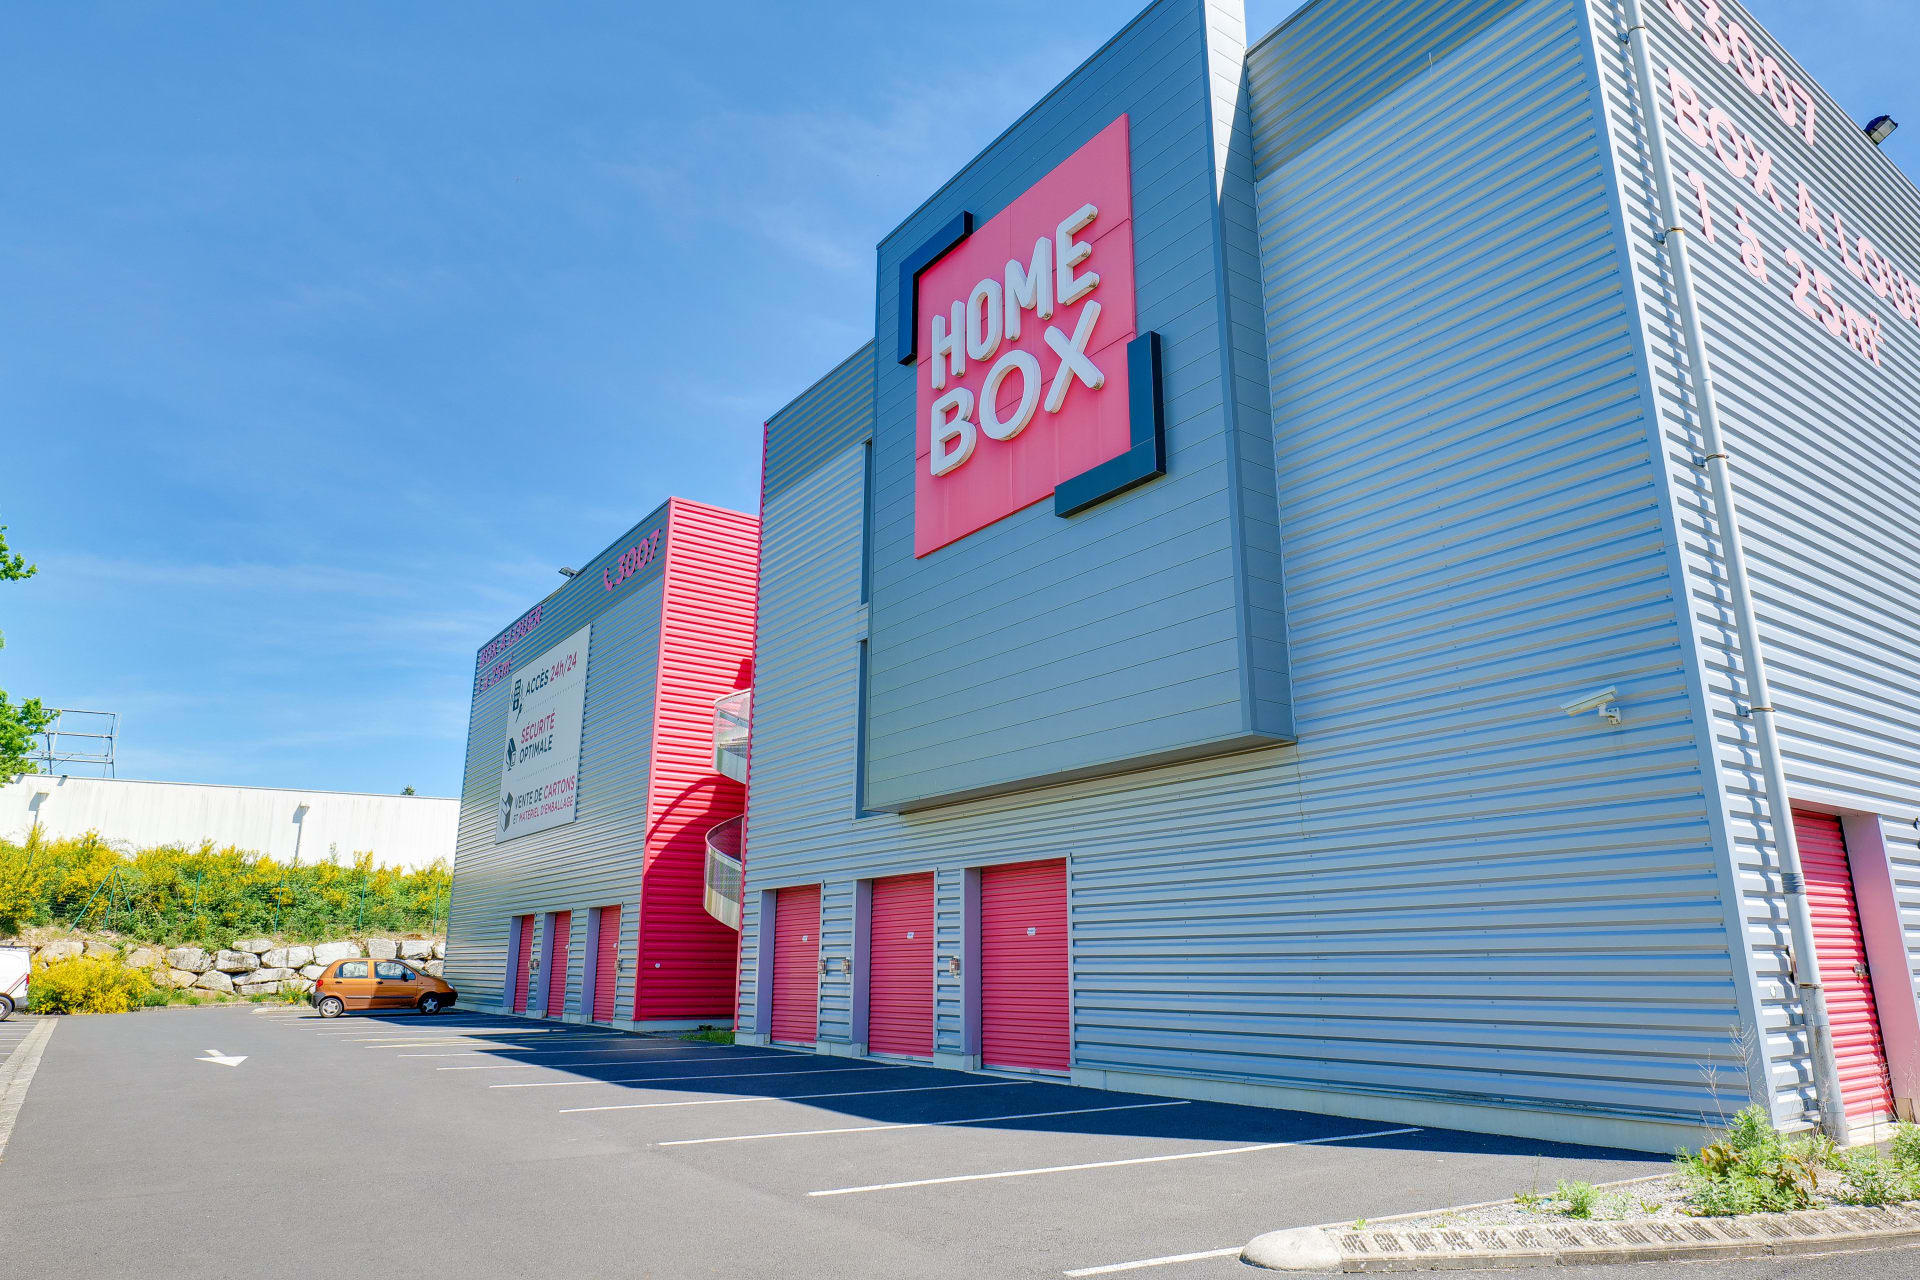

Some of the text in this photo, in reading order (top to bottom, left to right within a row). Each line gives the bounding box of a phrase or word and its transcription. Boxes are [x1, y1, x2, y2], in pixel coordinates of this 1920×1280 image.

[1702, 0, 1815, 147] 3007
[1667, 66, 1783, 213] BOX
[1686, 171, 1715, 244] 1
[1735, 204, 1768, 284] à
[931, 203, 1100, 390] HOME
[930, 300, 1105, 477] BOX
[616, 529, 661, 586] 3007
[525, 650, 578, 698] ACCÈS 24h/24
[519, 734, 553, 764] OPTIMALE
[520, 706, 556, 745] SÉCURITÉ
[512, 795, 574, 825] ET MATÉRIEL D'EMBALLAGE
[515, 775, 576, 809] VENTE DE CARTONS
